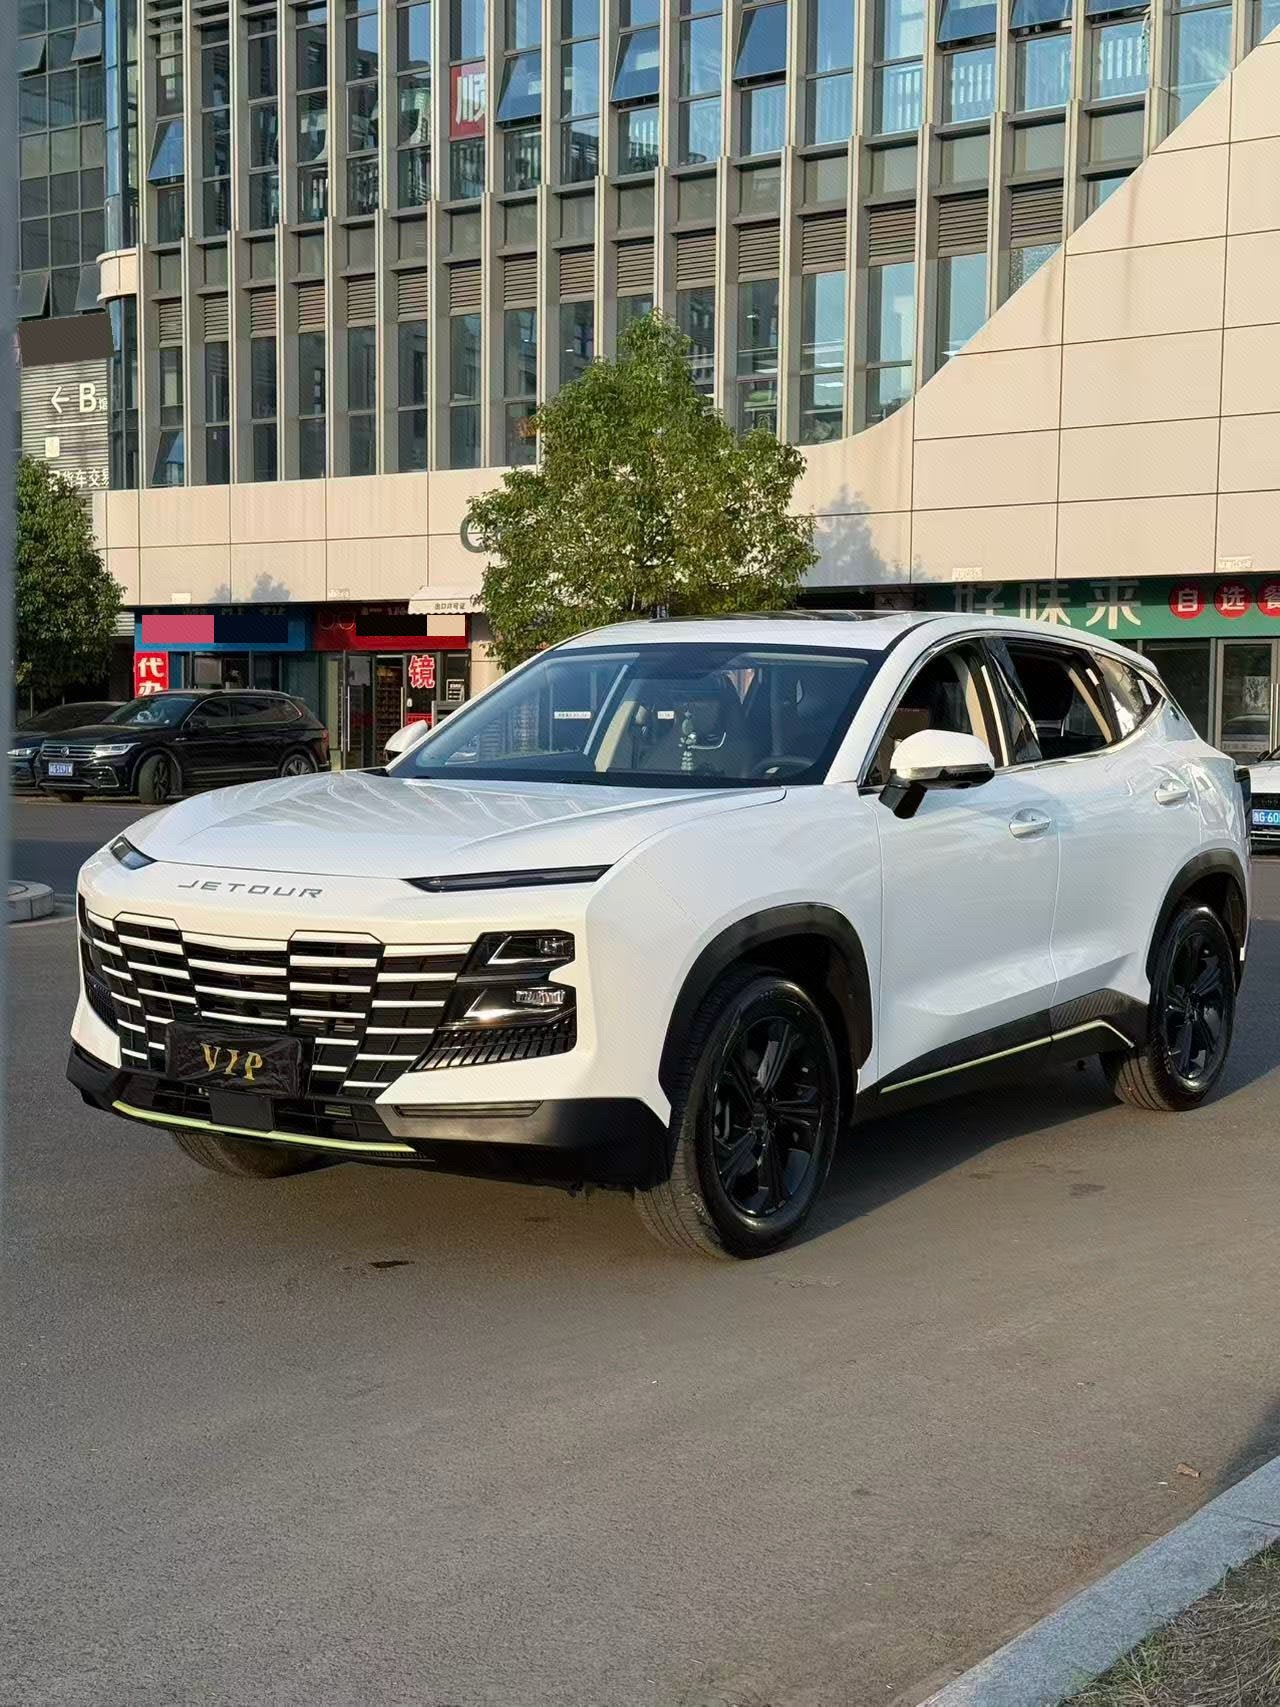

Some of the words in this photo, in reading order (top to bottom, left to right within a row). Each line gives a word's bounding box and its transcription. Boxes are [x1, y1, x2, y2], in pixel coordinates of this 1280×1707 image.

[953, 577, 1142, 630] 好味来
[408, 655, 435, 689] 镜
[177, 880, 323, 899] JETOUR
[200, 1043, 263, 1081] VIP
